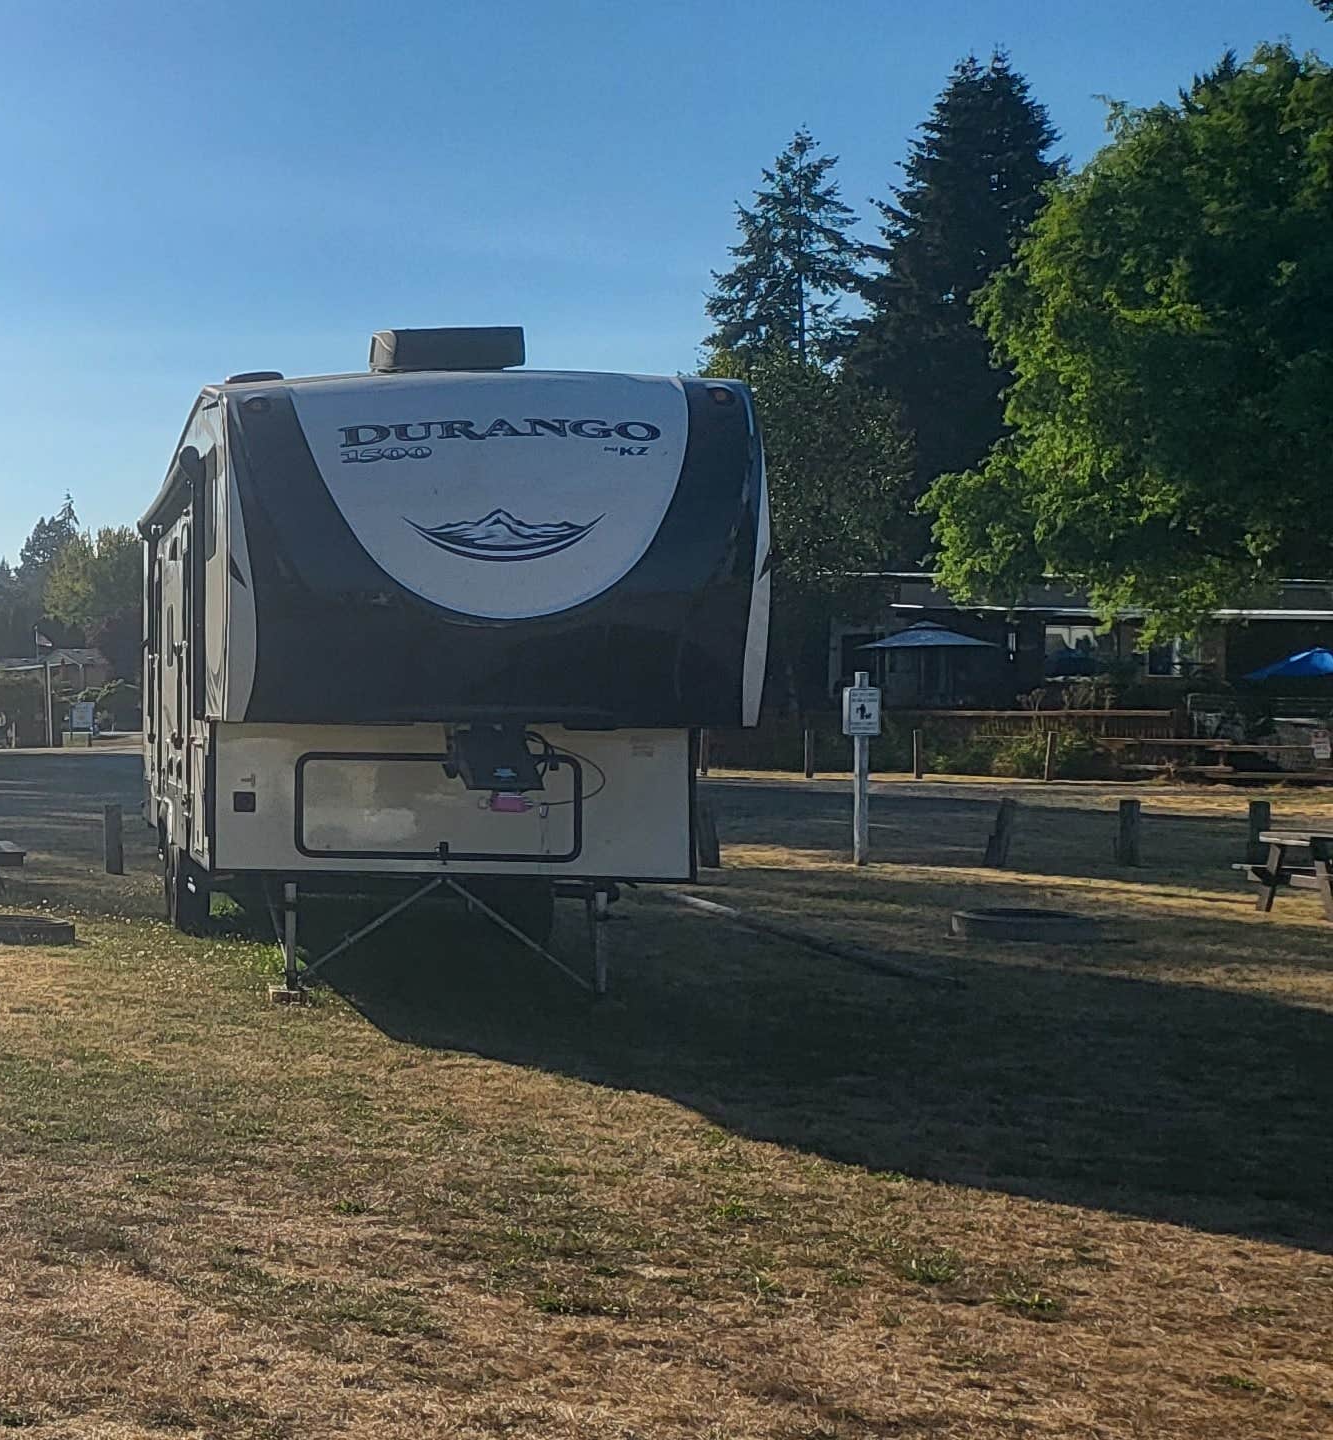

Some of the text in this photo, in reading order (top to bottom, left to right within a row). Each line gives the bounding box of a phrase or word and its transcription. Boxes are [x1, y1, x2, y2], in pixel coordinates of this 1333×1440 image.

[337, 418, 661, 448] DURANGO
[340, 446, 432, 463] 1500
[619, 446, 649, 456] KZ
